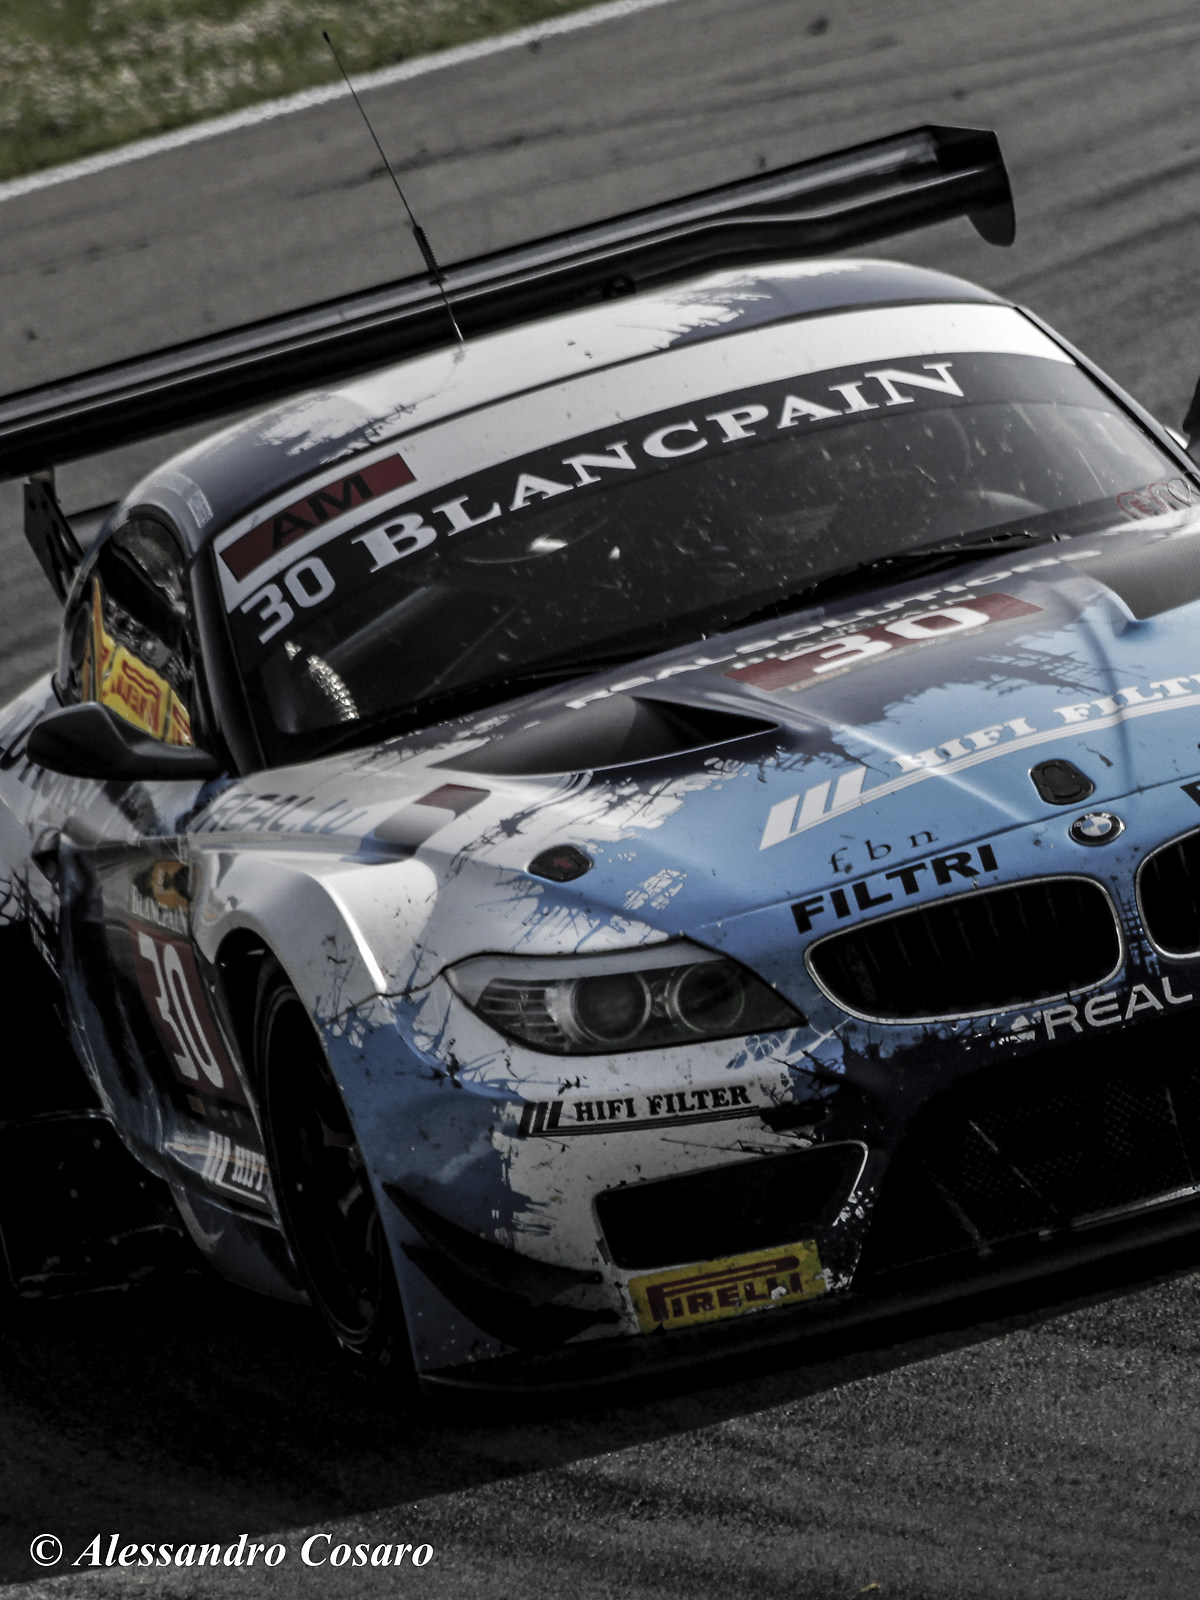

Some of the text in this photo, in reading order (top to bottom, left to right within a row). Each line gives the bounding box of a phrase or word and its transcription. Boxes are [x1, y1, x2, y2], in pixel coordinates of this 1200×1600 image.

[351, 361, 965, 573] BLANCPAIN
[271, 473, 372, 552] AM
[240, 555, 336, 644] 30
[778, 606, 992, 674] 30
[891, 715, 1038, 773] HIFI
[792, 843, 1000, 934] FILTRI
[138, 930, 224, 1089] 30
[1042, 976, 1193, 1040] REAL
[574, 1084, 751, 1124] HIFI FILTER
[646, 1256, 801, 1322] PIRELLI
